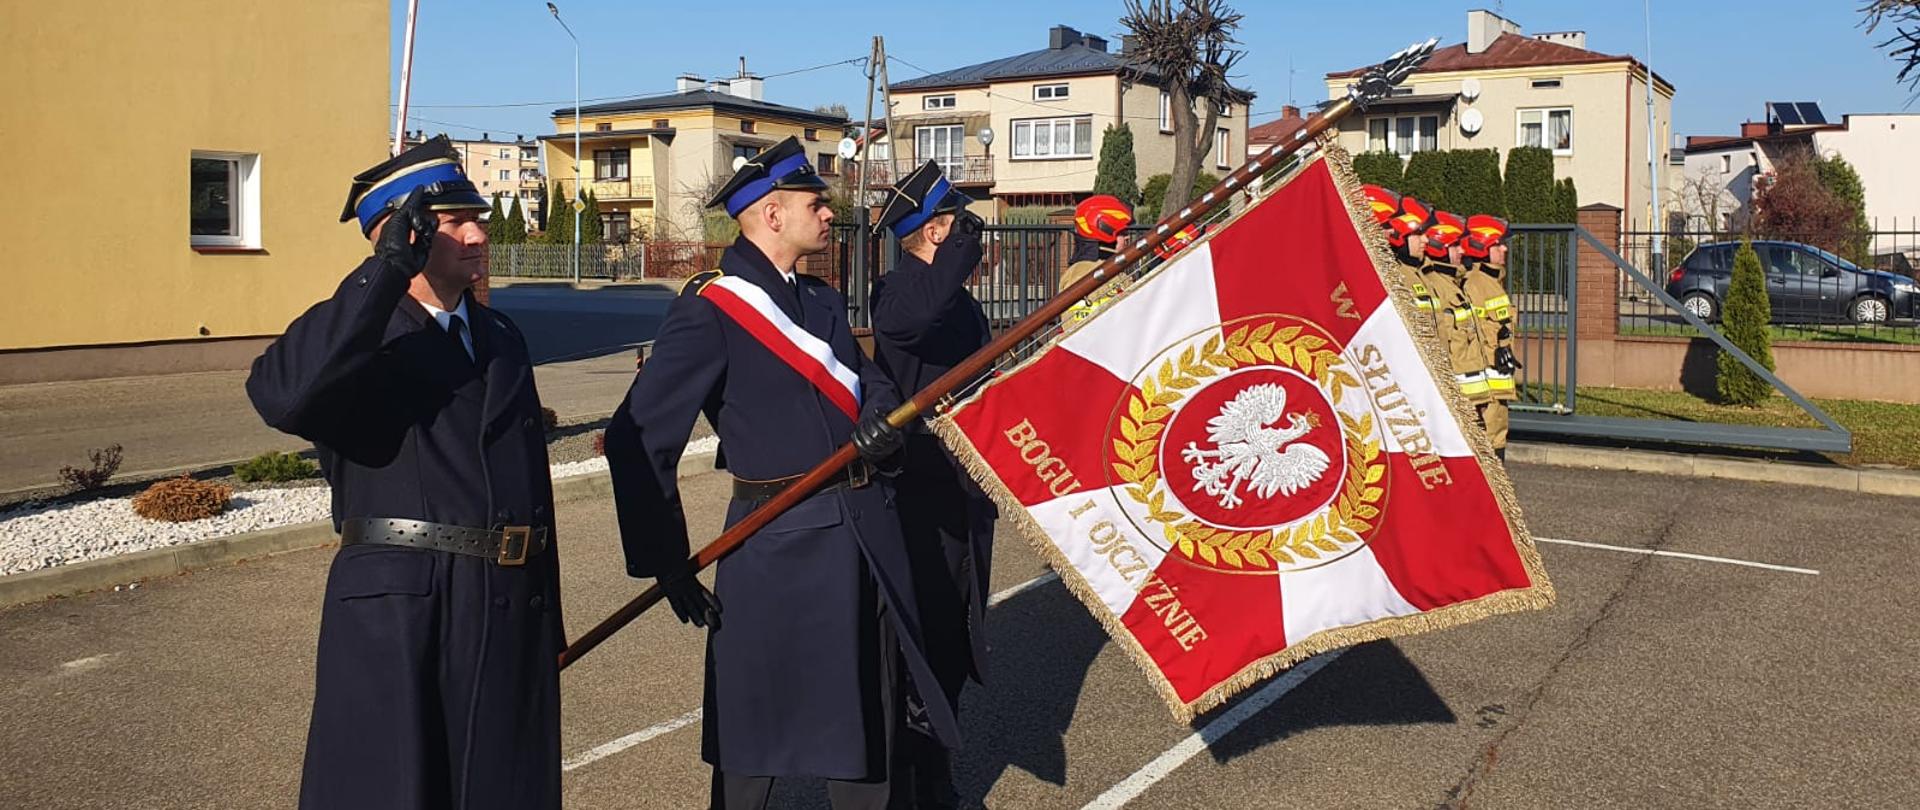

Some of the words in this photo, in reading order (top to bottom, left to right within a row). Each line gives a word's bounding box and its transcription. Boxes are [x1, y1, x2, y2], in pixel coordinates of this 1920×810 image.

[1330, 281, 1362, 320] W
[1353, 344, 1453, 490] SŁUŻBIE
[1003, 418, 1082, 496] BOGU
[1068, 498, 1097, 519] I
[1088, 520, 1208, 652] OJCZYŹNIE
